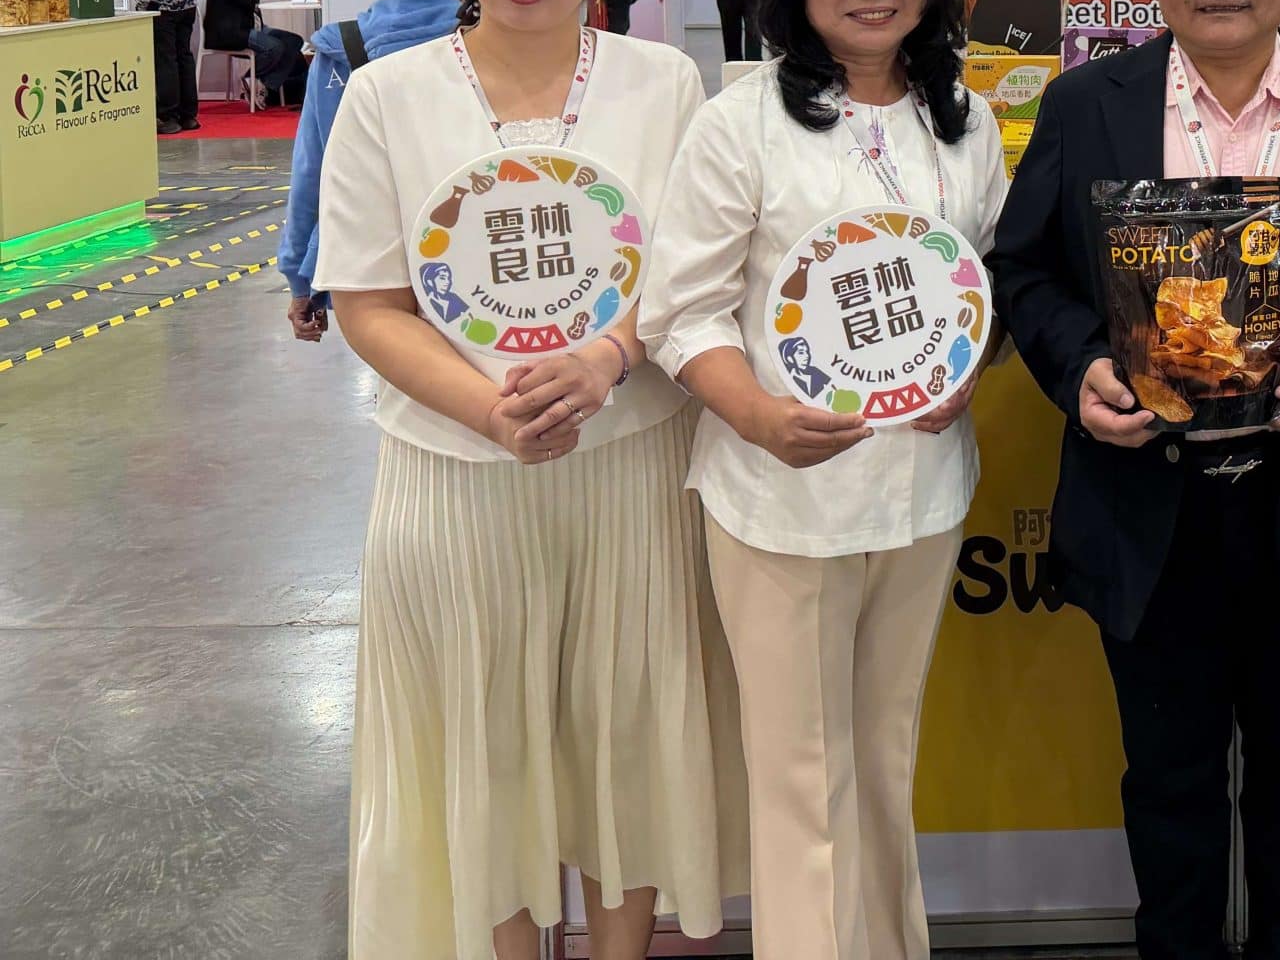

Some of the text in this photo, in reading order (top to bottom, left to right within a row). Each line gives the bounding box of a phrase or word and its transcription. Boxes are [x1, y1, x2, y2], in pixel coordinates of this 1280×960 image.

[1011, 27, 1027, 40] ICE
[1115, 1, 1161, 24] Pot
[84, 60, 139, 103] Reka
[325, 67, 345, 89] A
[56, 104, 140, 130] Flavour & Fragrance
[484, 202, 573, 245] 雲林
[1108, 226, 1173, 245] SWEET
[489, 241, 575, 285] 良品
[831, 256, 916, 311] 雲林
[470, 266, 599, 319] YUNLIN GOODS
[841, 295, 924, 351] 良品
[830, 317, 947, 383] YUNLIN GOODS
[1013, 508, 1049, 545] 阿
[953, 535, 1064, 615] Sw
